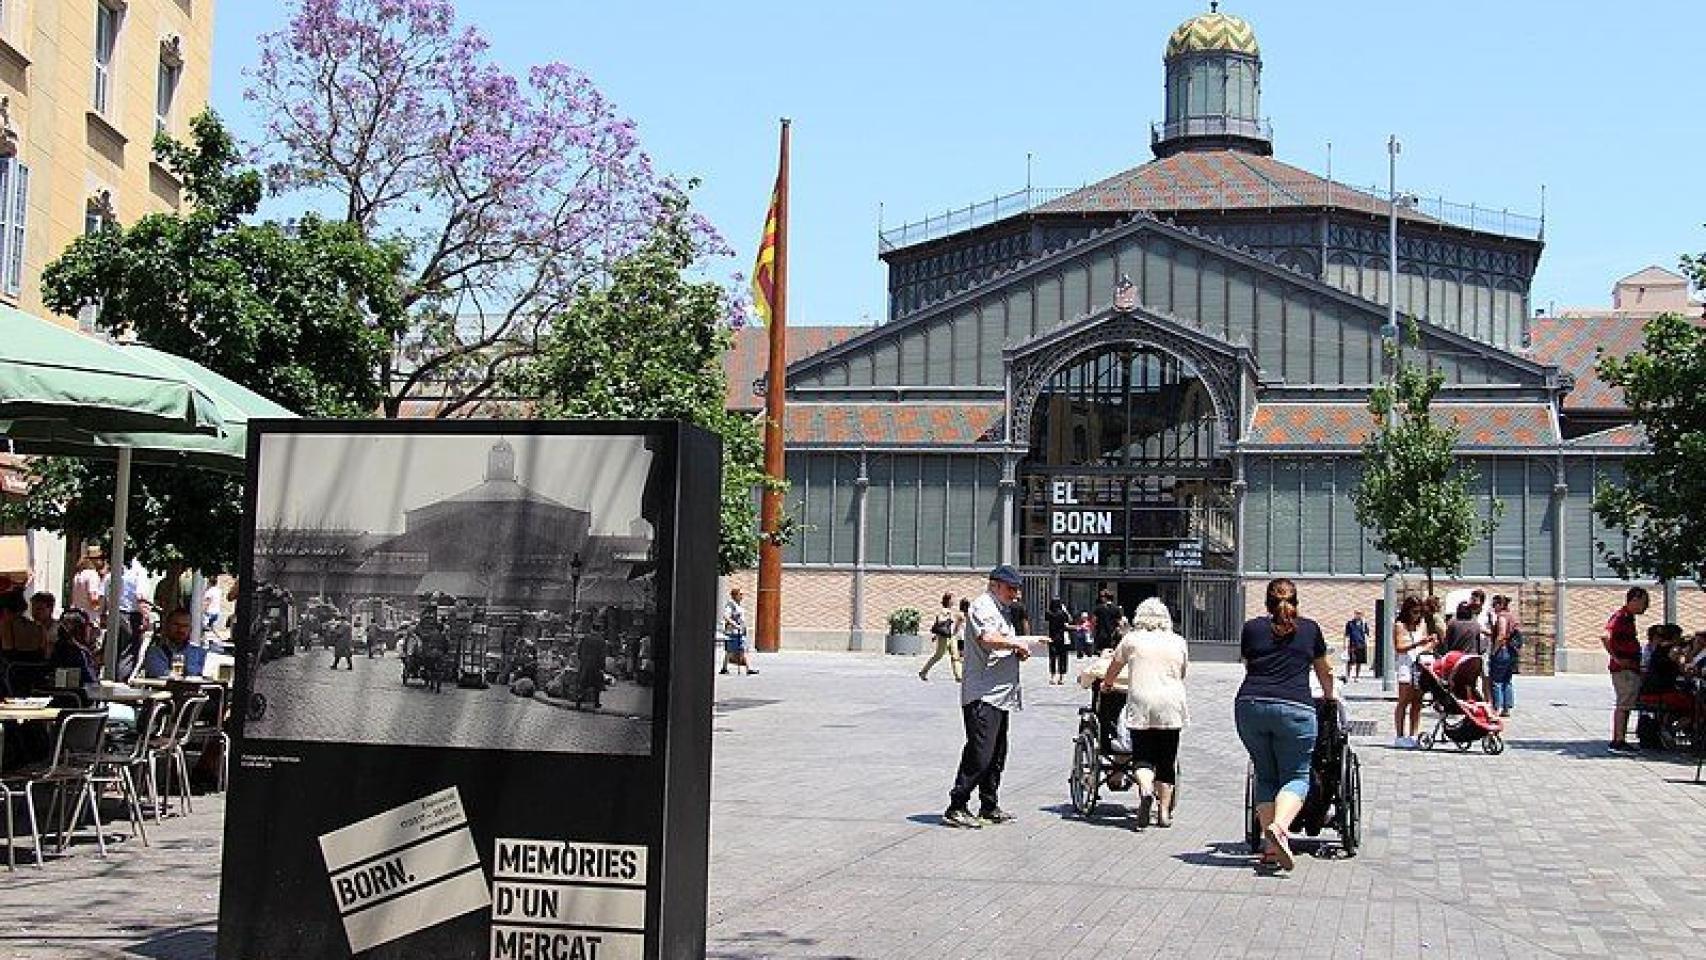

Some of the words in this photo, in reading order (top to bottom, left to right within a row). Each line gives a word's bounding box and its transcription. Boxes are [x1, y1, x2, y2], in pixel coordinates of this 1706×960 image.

[1052, 481, 1078, 504] EL
[1052, 511, 1112, 534] BORN
[1052, 541, 1099, 564] CCM
[498, 839, 637, 878] MEMÒRIES
[336, 857, 416, 907] BORN.
[498, 886, 558, 919] D'UN
[495, 929, 602, 960] MERCAT
